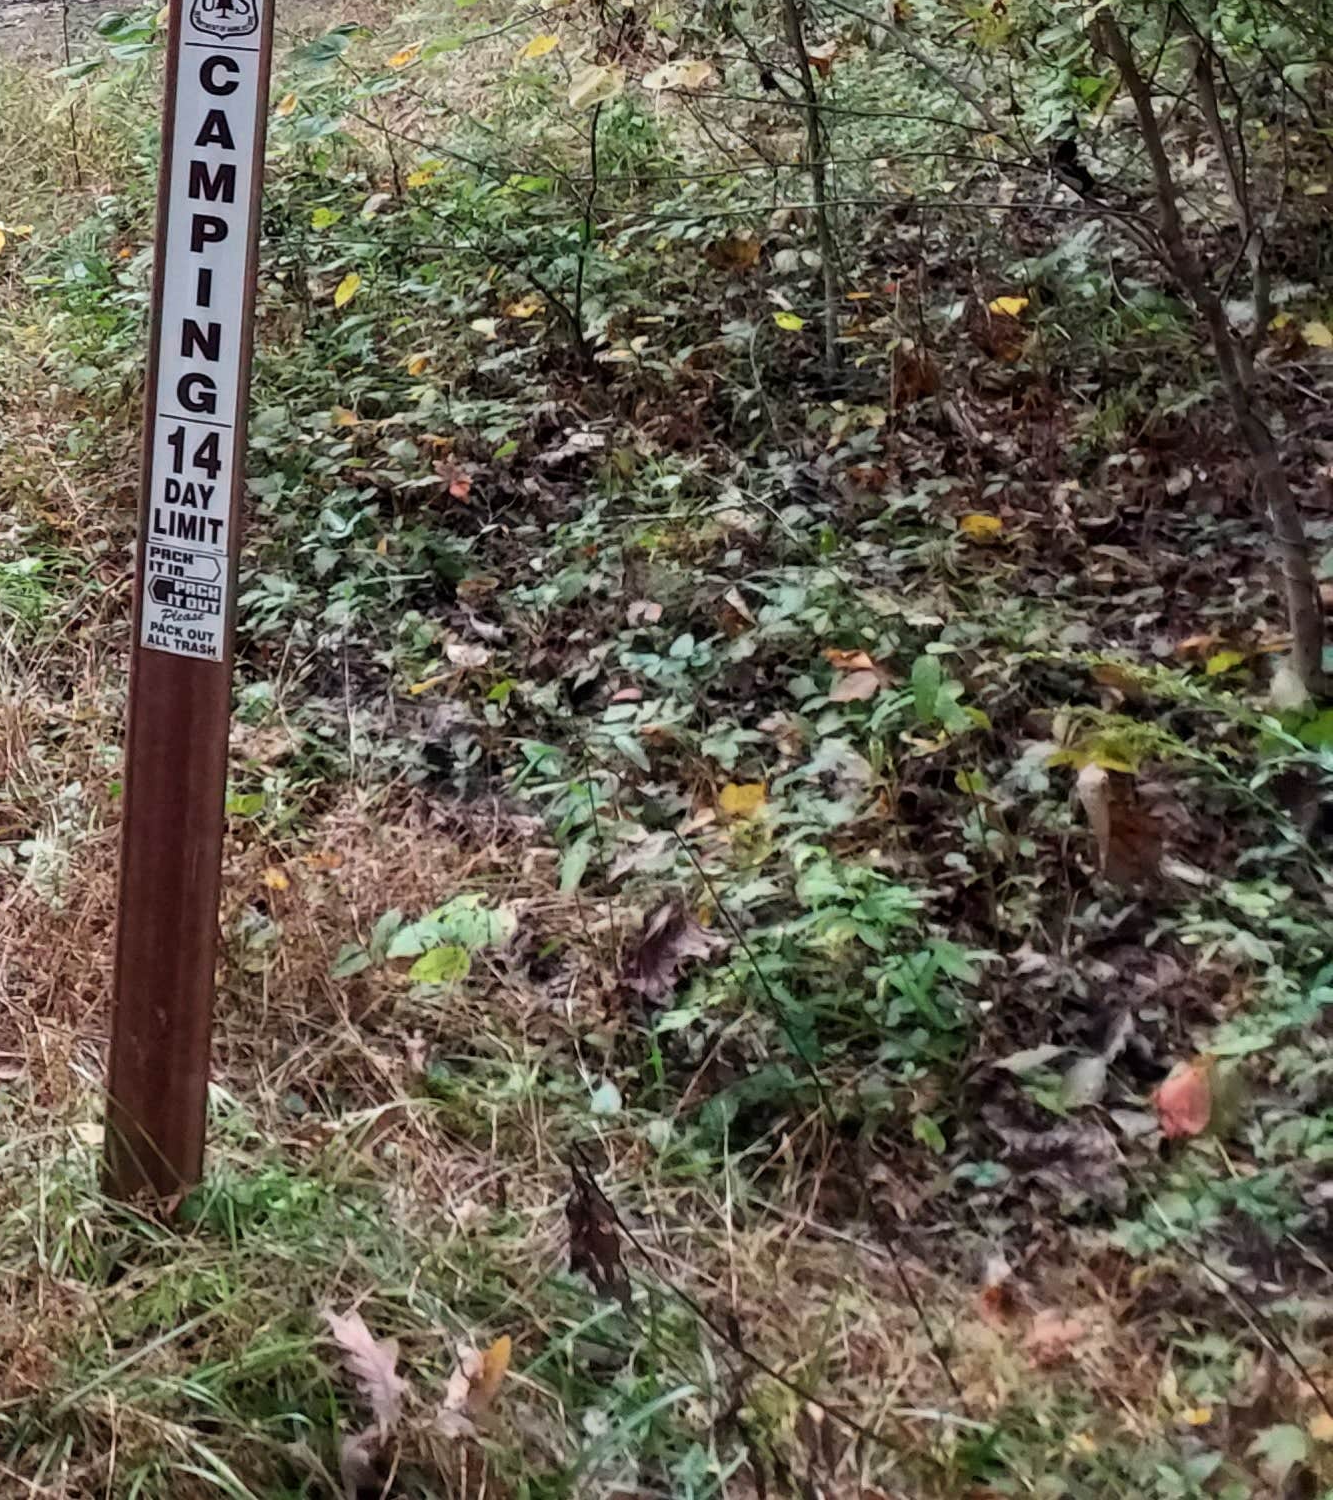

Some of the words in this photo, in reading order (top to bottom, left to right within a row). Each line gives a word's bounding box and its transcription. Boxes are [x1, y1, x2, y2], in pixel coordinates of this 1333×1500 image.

[176, 54, 240, 416] CAMPING
[167, 425, 222, 480] 14
[164, 478, 216, 510] DAY
[153, 507, 224, 544] LIMIT
[150, 546, 194, 565] PACK
[149, 560, 165, 573] IT
[174, 580, 219, 599] PACK
[167, 593, 183, 607] IT
[186, 597, 219, 614] OUT
[160, 608, 205, 622] Please
[150, 621, 183, 637] PACK
[187, 629, 215, 642] OUT
[147, 633, 169, 647] ALL
[173, 639, 216, 656] TRASH
